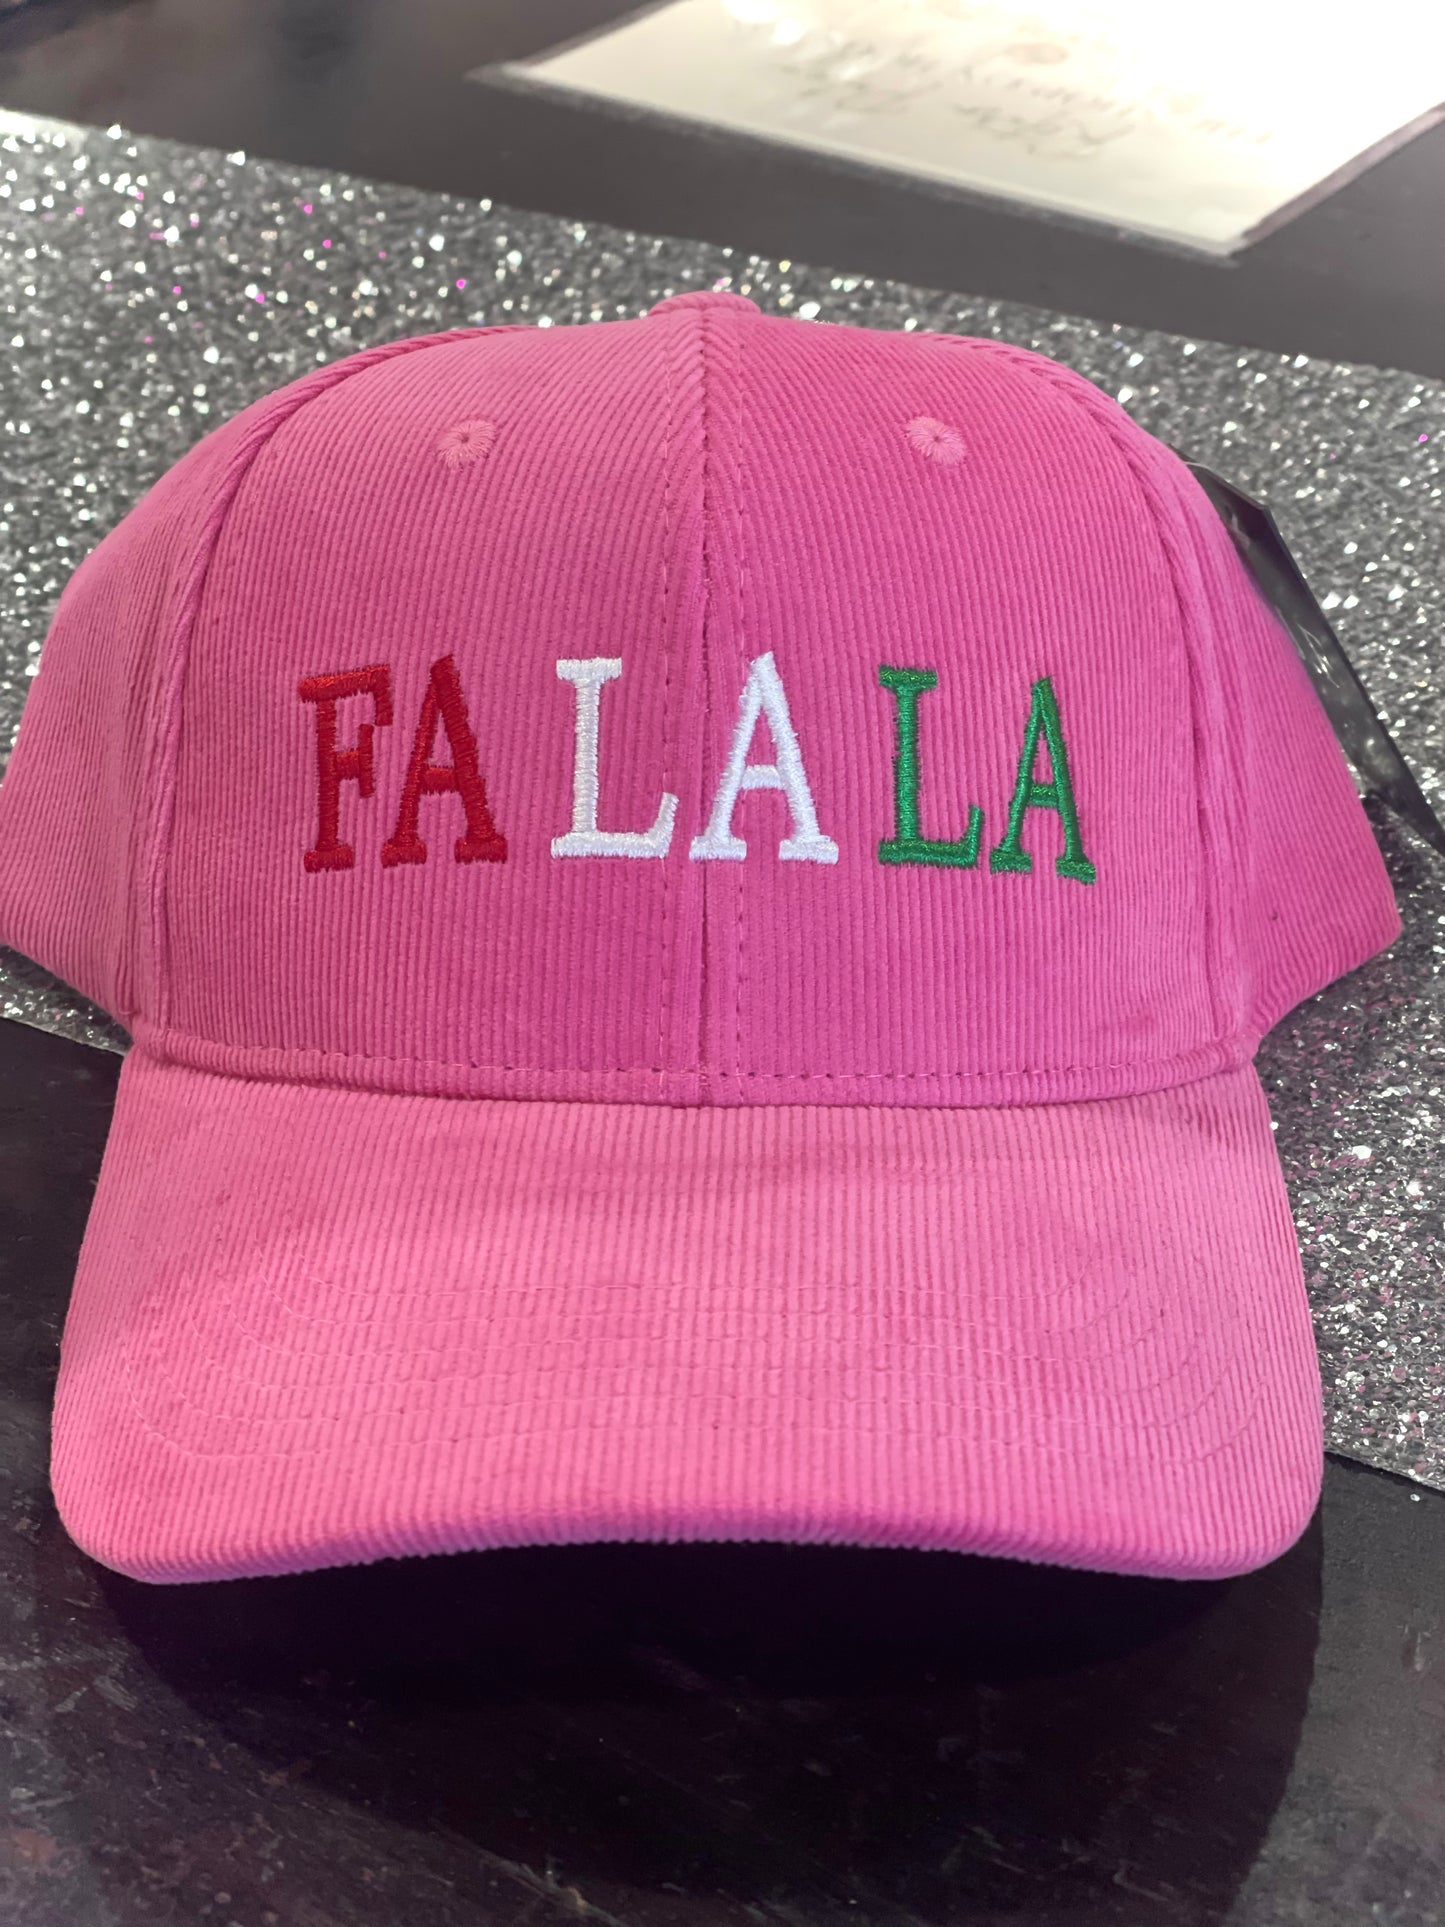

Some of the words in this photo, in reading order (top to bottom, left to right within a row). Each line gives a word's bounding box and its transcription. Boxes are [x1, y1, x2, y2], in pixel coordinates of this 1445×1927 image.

[298, 654, 507, 873] FA
[551, 651, 839, 864] LA
[878, 665, 1096, 884] LA
